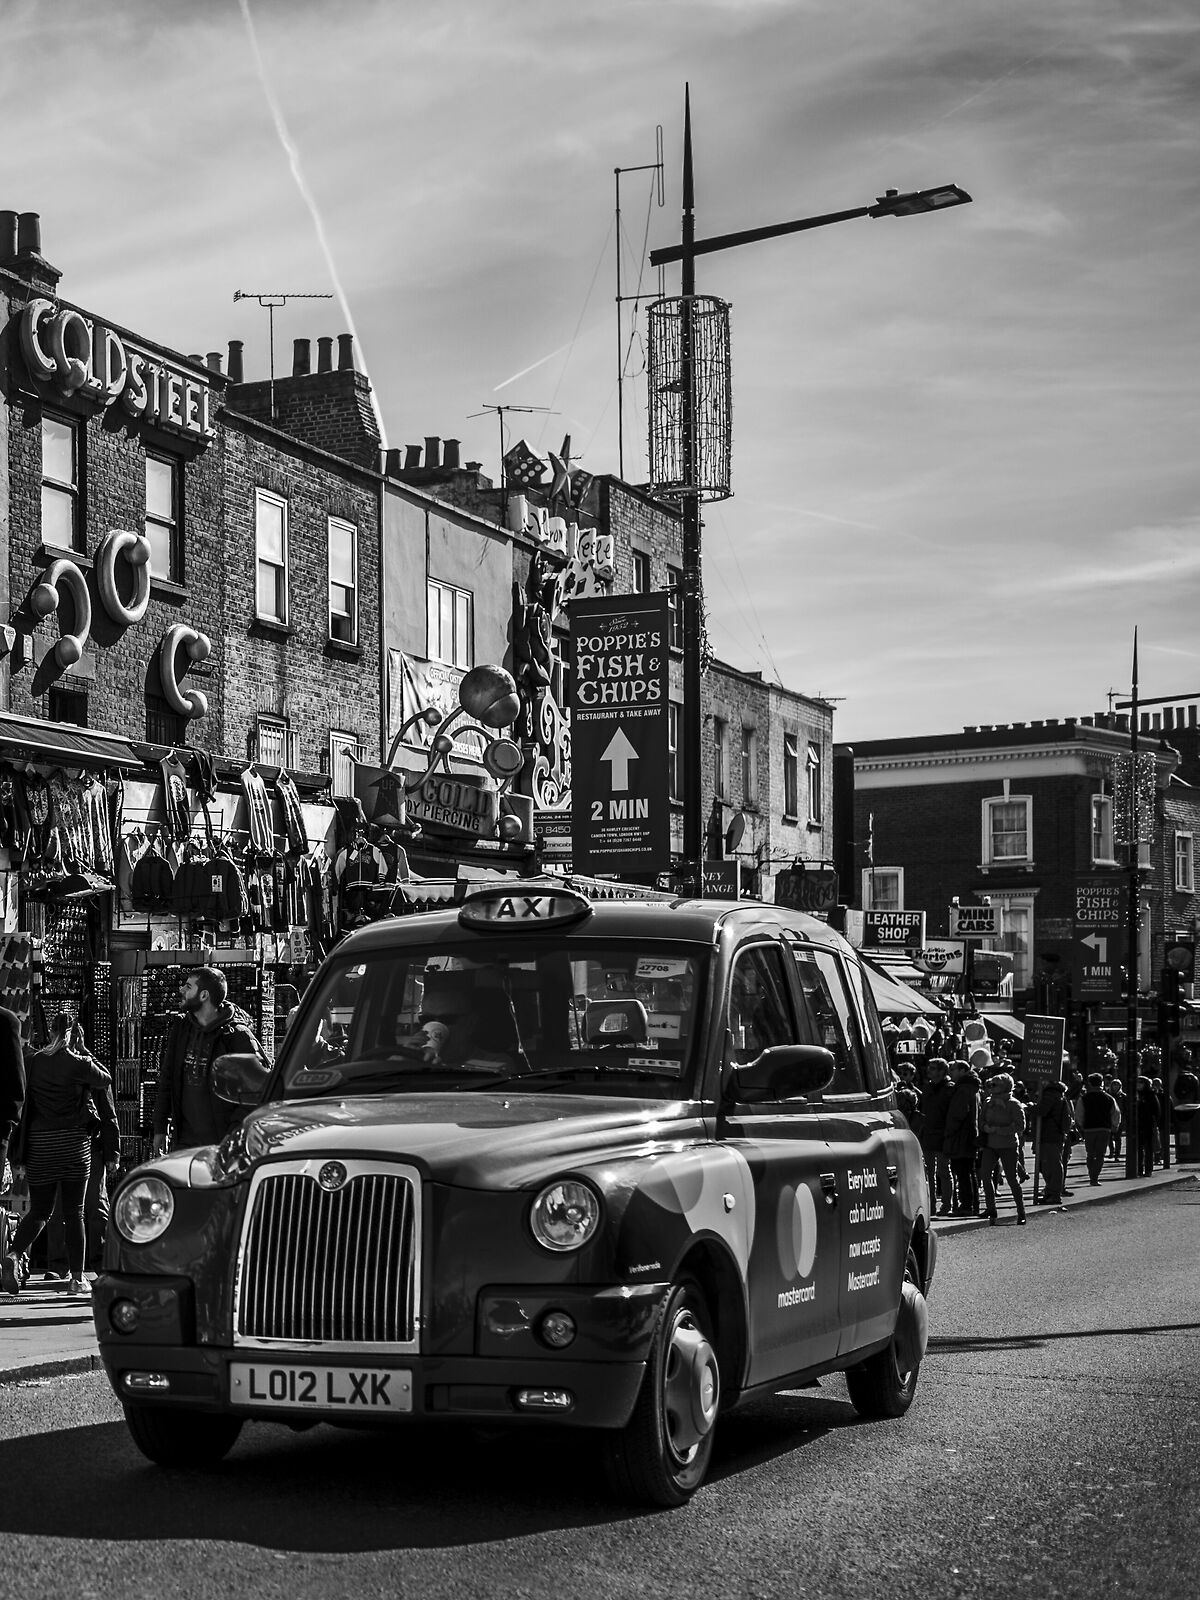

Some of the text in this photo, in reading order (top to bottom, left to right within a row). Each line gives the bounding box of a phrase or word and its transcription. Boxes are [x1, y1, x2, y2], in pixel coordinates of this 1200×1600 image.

[123, 353, 218, 441] STEEL
[576, 631, 661, 653] POPPIE'S
[576, 653, 661, 680] FISH &
[576, 678, 661, 705] CHIPS
[576, 711, 618, 721] RESTAURANT
[626, 710, 642, 718] TAKE
[643, 708, 661, 717] AWAY
[405, 800, 421, 815] DY
[423, 803, 480, 831] PIERCING
[590, 798, 649, 821] 2 MIN
[545, 825, 571, 834] 8450
[703, 872, 725, 881] NEY
[481, 897, 556, 919] TAXI
[1076, 896, 1111, 909] FISH
[866, 913, 921, 926] LEATHER
[957, 920, 995, 931] CABS
[958, 909, 995, 921] MINI
[1076, 908, 1120, 921] CHIPS
[877, 926, 910, 940] SHOP
[638, 964, 669, 972] 47708
[1082, 966, 1112, 976] 1 MIN
[847, 1167, 878, 1194] Every black
[849, 1200, 885, 1224] cab in London
[848, 1235, 881, 1258] now accepts
[777, 1281, 816, 1309] mastercard
[248, 1368, 392, 1406] LO12 LXK
